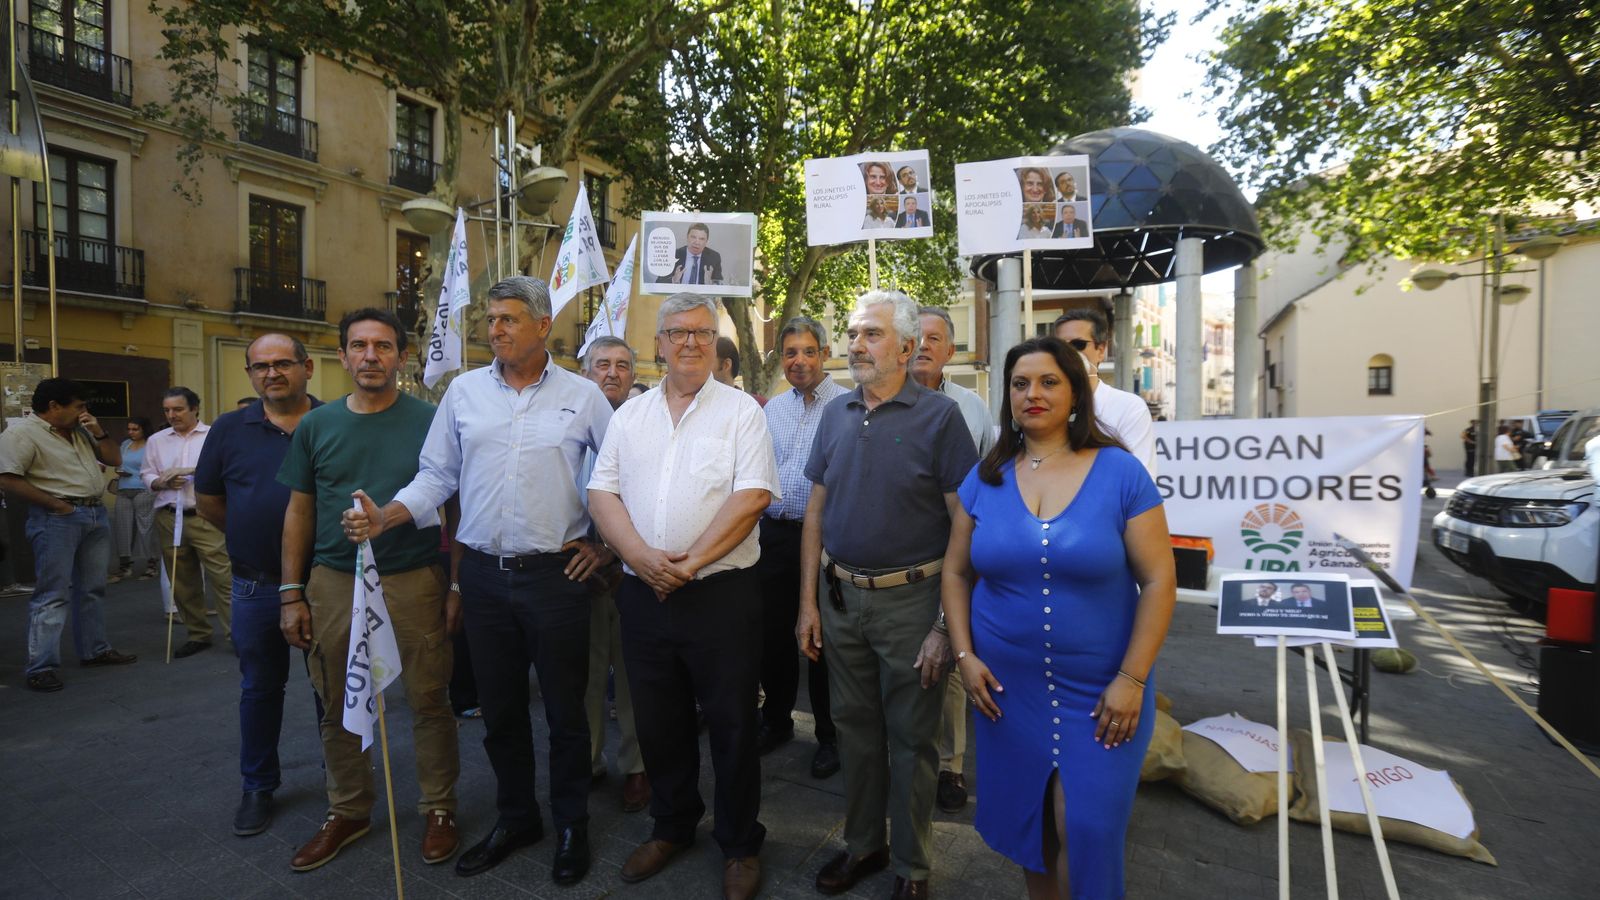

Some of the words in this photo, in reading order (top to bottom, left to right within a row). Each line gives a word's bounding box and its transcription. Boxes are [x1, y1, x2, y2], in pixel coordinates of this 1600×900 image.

[825, 186, 845, 194] JINETES
[813, 193, 848, 201] APOCALIPSIS
[965, 193, 976, 201] LOS
[977, 191, 1000, 200] JINETES
[965, 200, 1002, 208] APOCALIPSIS
[1156, 434, 1324, 461] AHOGAN
[1205, 724, 1280, 753] NARANJAS
[1352, 765, 1414, 792] RIGO
